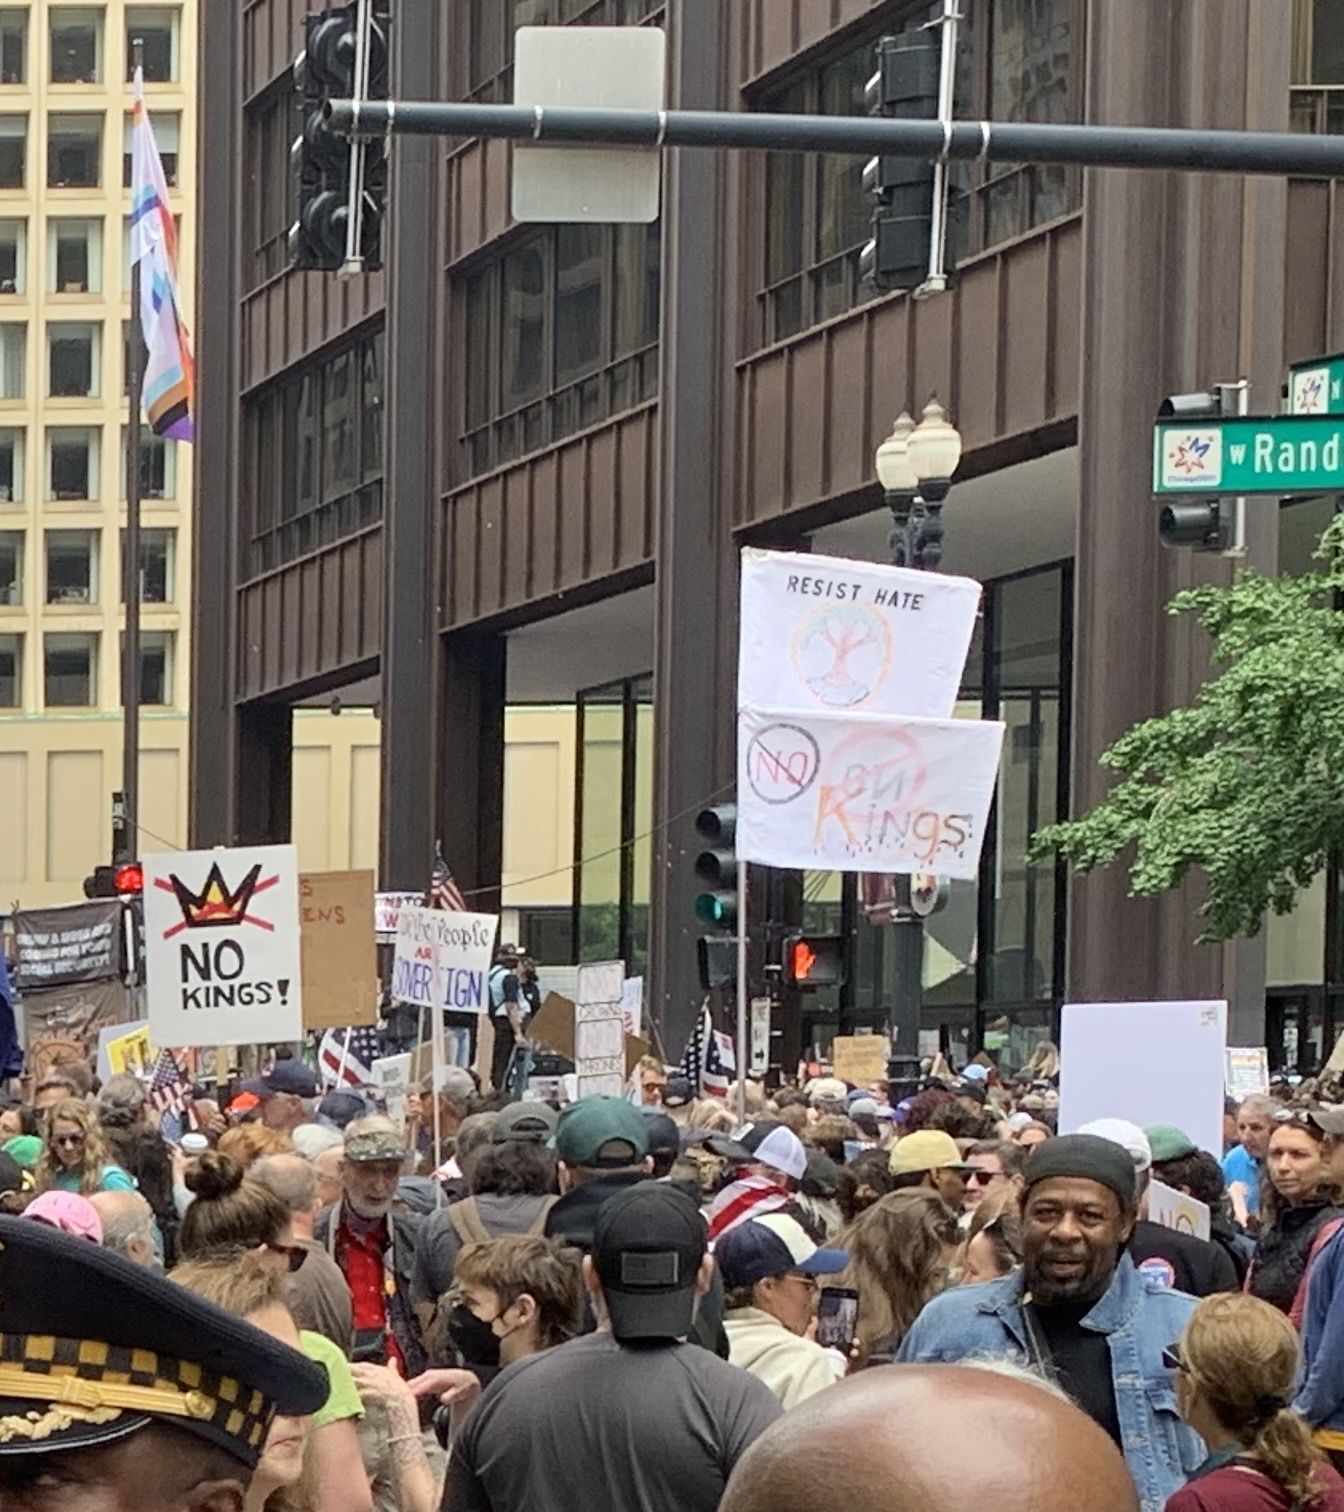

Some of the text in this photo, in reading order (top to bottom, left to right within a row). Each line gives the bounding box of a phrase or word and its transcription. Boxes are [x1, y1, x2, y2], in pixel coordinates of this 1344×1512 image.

[1230, 444, 1247, 465] W
[787, 575, 925, 612] RESIST HATE
[179, 938, 245, 984] NO
[181, 978, 290, 1010] KINGS!
[395, 955, 483, 1007] SOVERIGN
